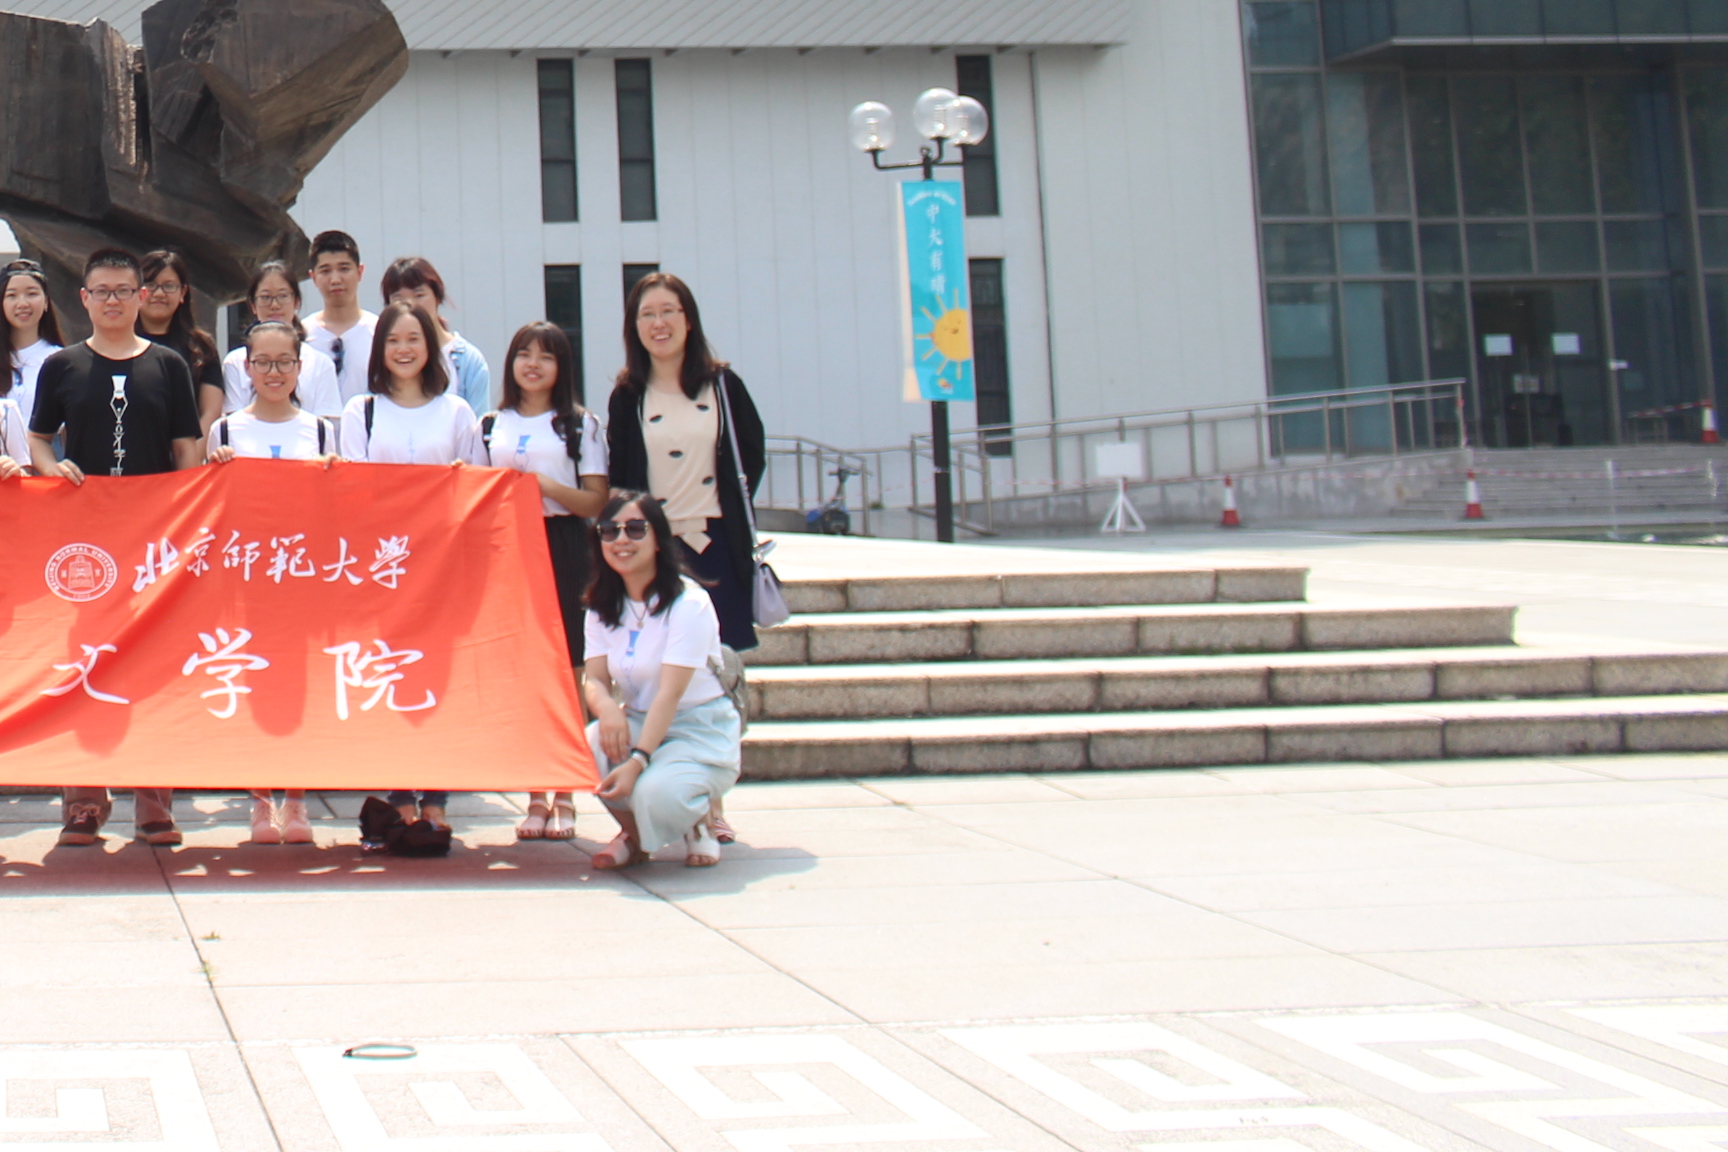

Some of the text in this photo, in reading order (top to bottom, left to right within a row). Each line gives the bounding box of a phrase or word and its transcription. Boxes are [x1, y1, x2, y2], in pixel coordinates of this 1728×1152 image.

[55, 546, 90, 562] NORMAL
[132, 527, 411, 594] 北京師範大學
[40, 627, 436, 720] 文学院
